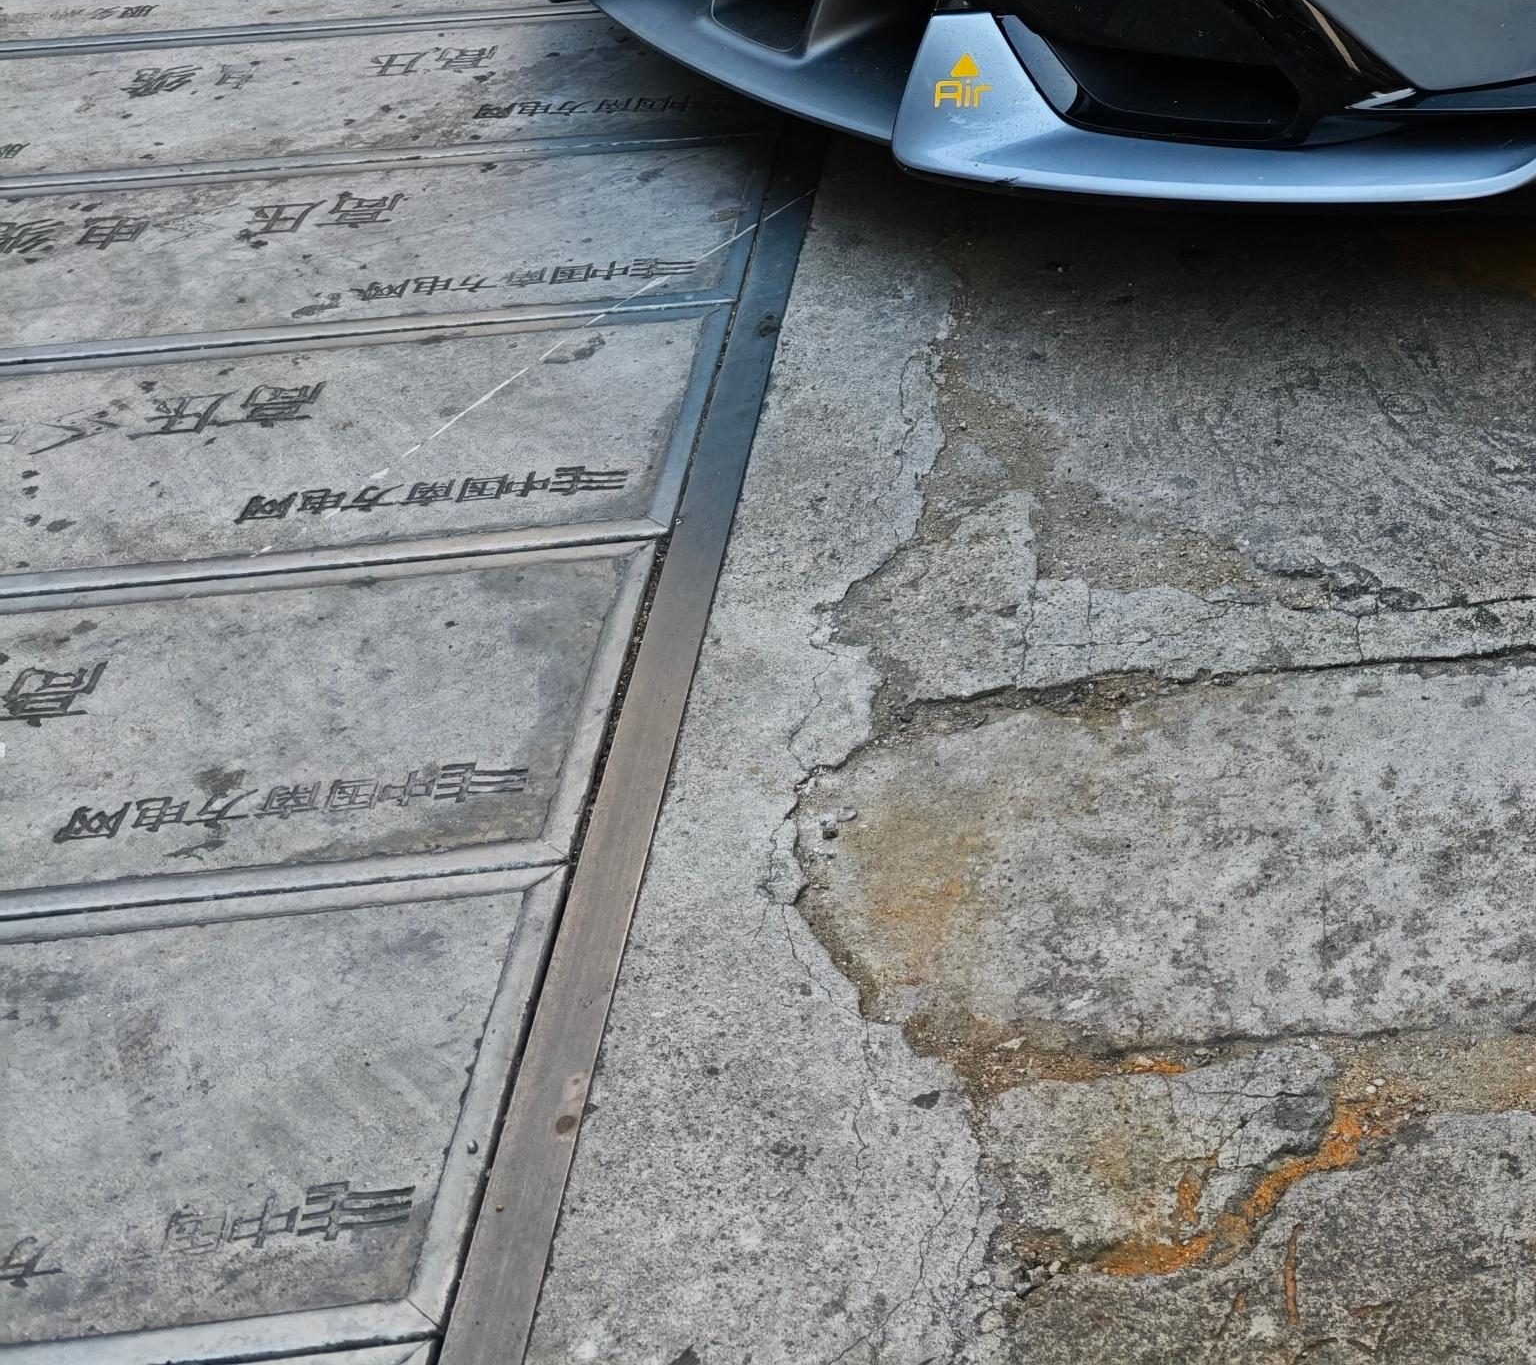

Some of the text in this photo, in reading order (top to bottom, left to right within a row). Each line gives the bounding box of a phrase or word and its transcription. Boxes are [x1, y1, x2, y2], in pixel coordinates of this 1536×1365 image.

[933, 78, 992, 110] Air
[247, 191, 408, 235] 高压
[365, 262, 630, 302] 中国南方电网
[129, 381, 326, 441] 高压
[236, 470, 552, 525] 中国南方电网
[55, 769, 436, 845] 中国南方电网
